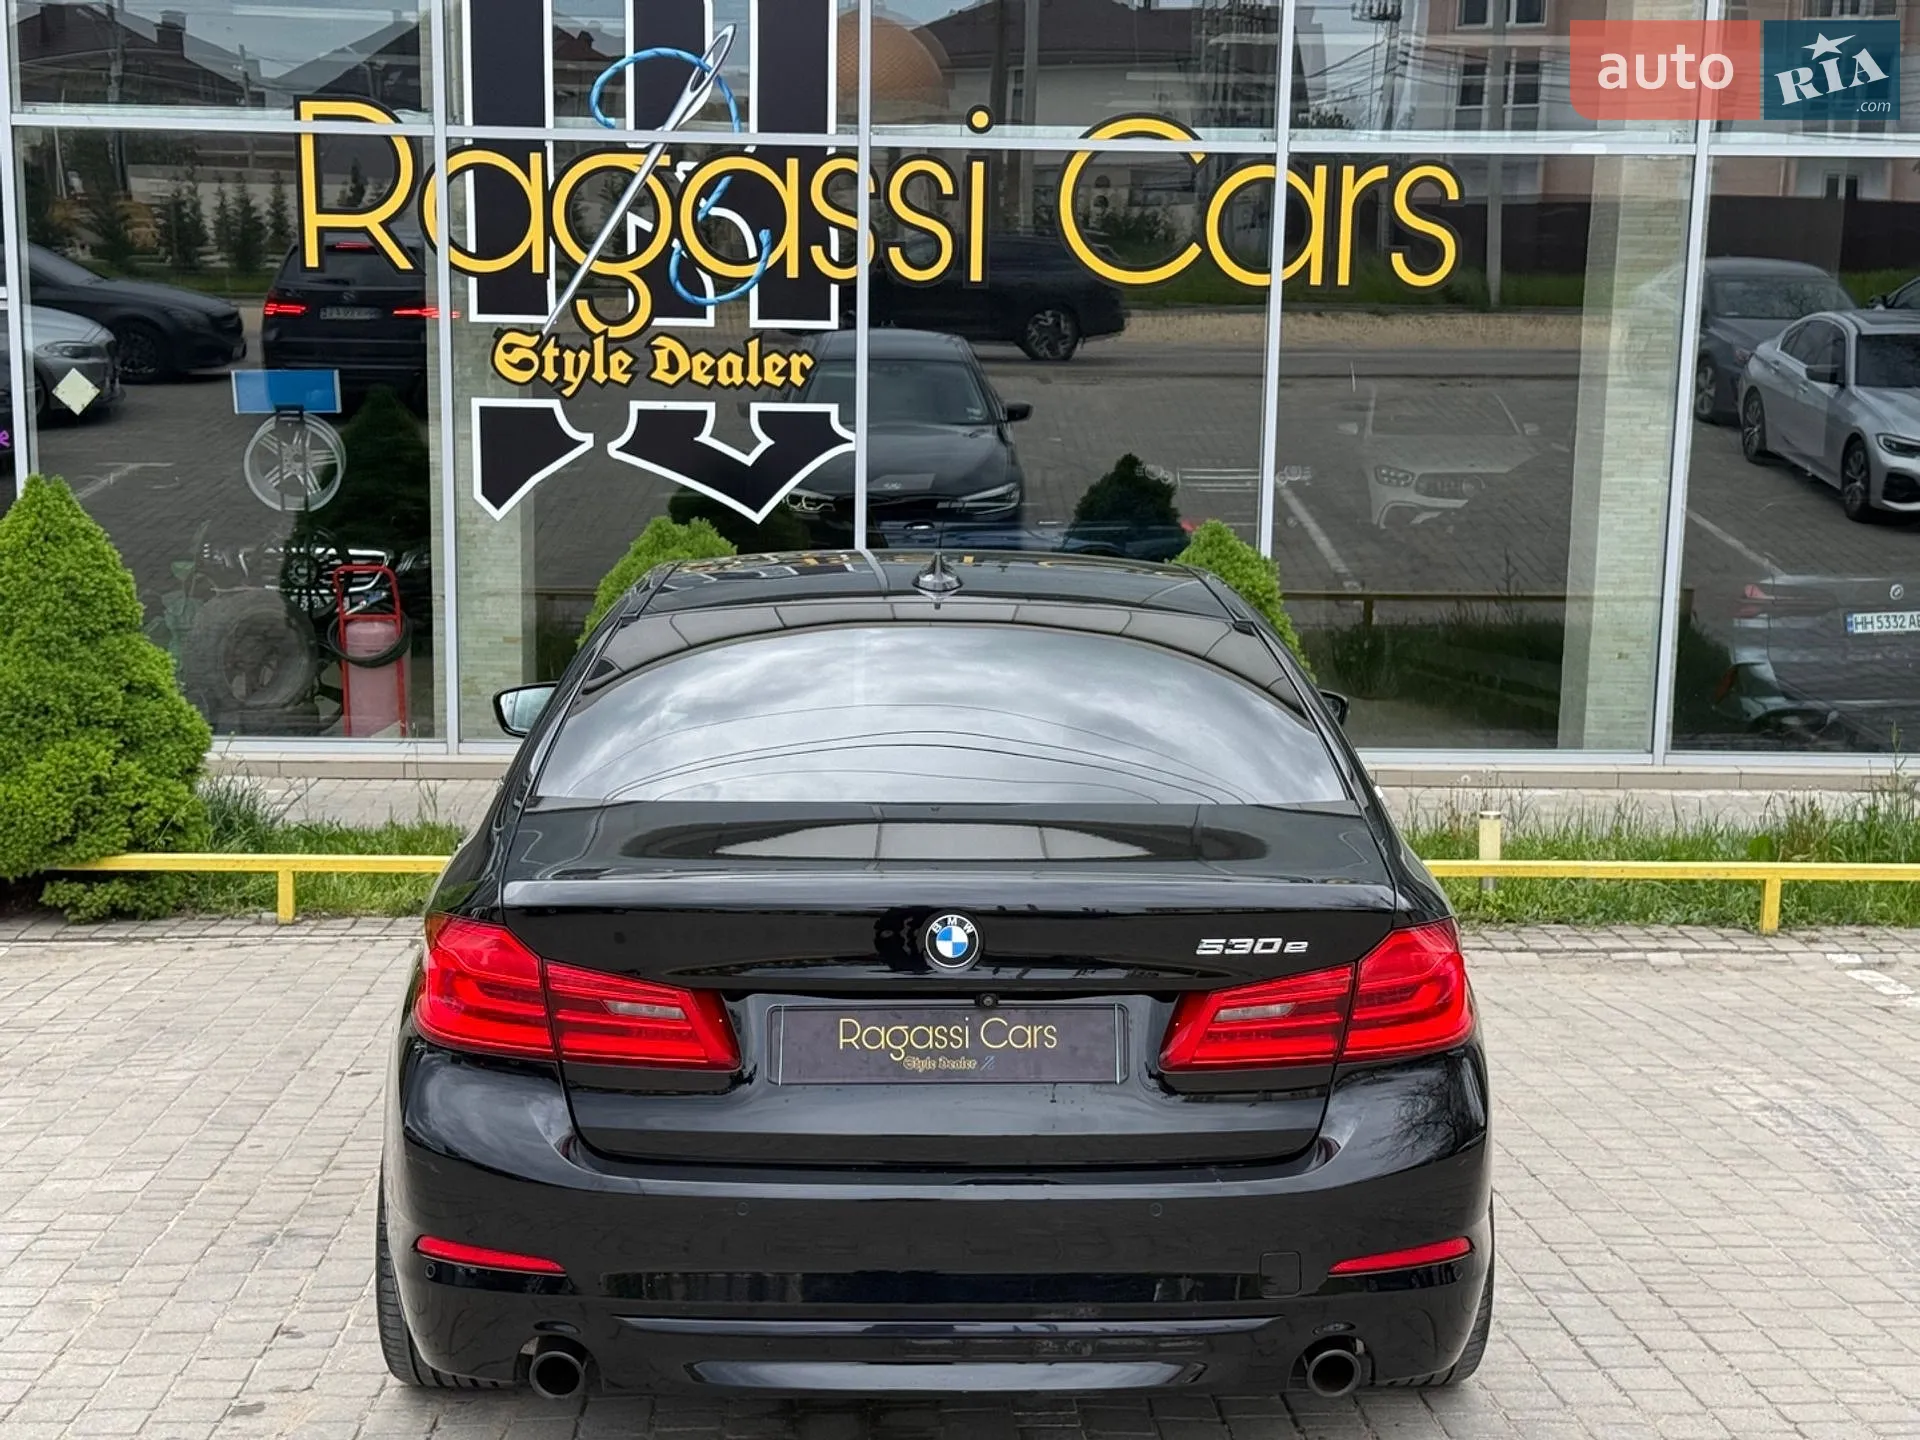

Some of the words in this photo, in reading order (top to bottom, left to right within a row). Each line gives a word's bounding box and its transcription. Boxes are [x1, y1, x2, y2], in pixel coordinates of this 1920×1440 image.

[297, 99, 990, 339] Ragassi
[1058, 117, 1461, 288] Cars
[493, 328, 635, 398] Style
[649, 334, 814, 389] Dealer
[1854, 616, 1875, 631] HH
[1876, 614, 1906, 630] 5332
[931, 917, 974, 934] BMW
[1196, 938, 1308, 955] 530e
[838, 1016, 970, 1061] Ragassi
[979, 1017, 1058, 1050] Cars
[903, 1056, 936, 1072] Style
